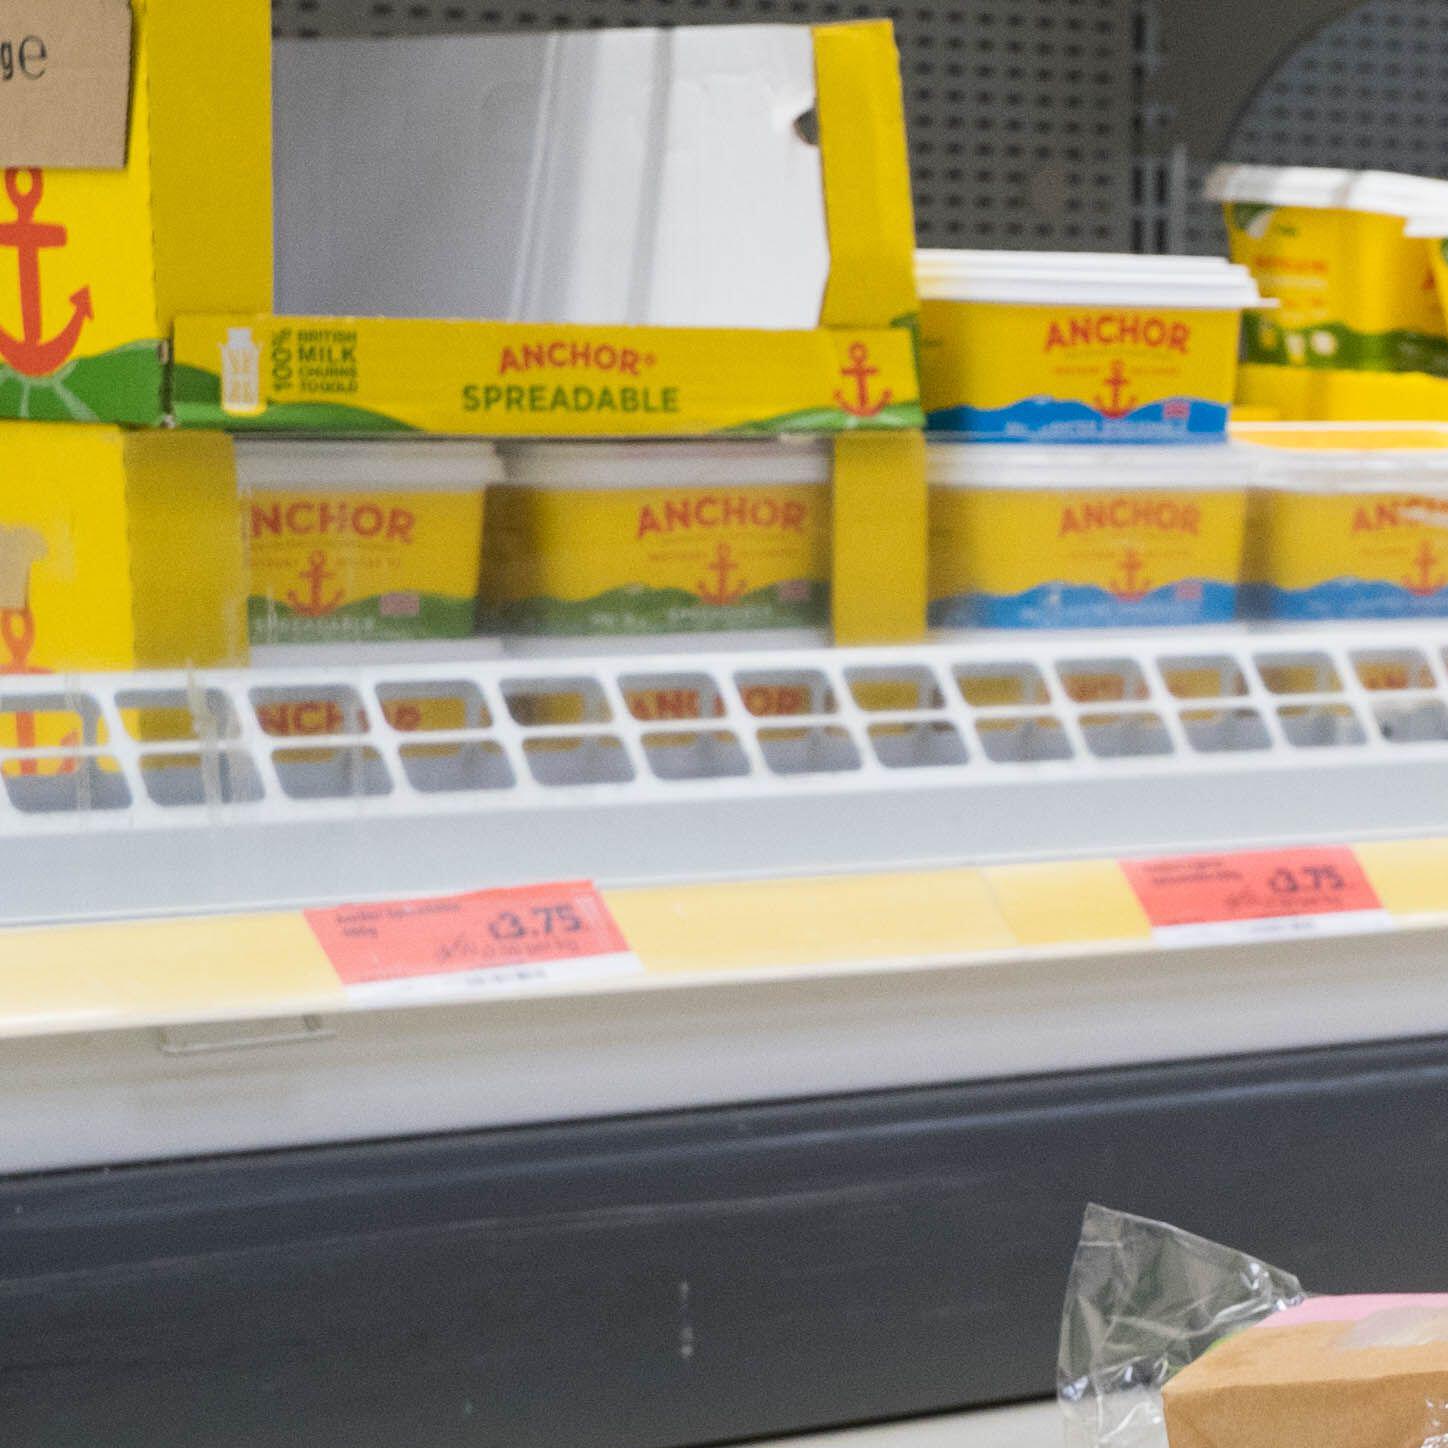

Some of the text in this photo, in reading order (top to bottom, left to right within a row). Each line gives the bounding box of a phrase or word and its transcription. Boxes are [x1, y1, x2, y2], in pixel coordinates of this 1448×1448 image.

[1043, 313, 1192, 356] ANCHOR
[297, 345, 357, 363] MILK
[498, 339, 642, 377] ANCHOR
[462, 384, 681, 415] SPREADABLE
[250, 498, 415, 545] NCHOR
[635, 496, 809, 539] ANCHOR
[1057, 499, 1200, 537] ANCHOR
